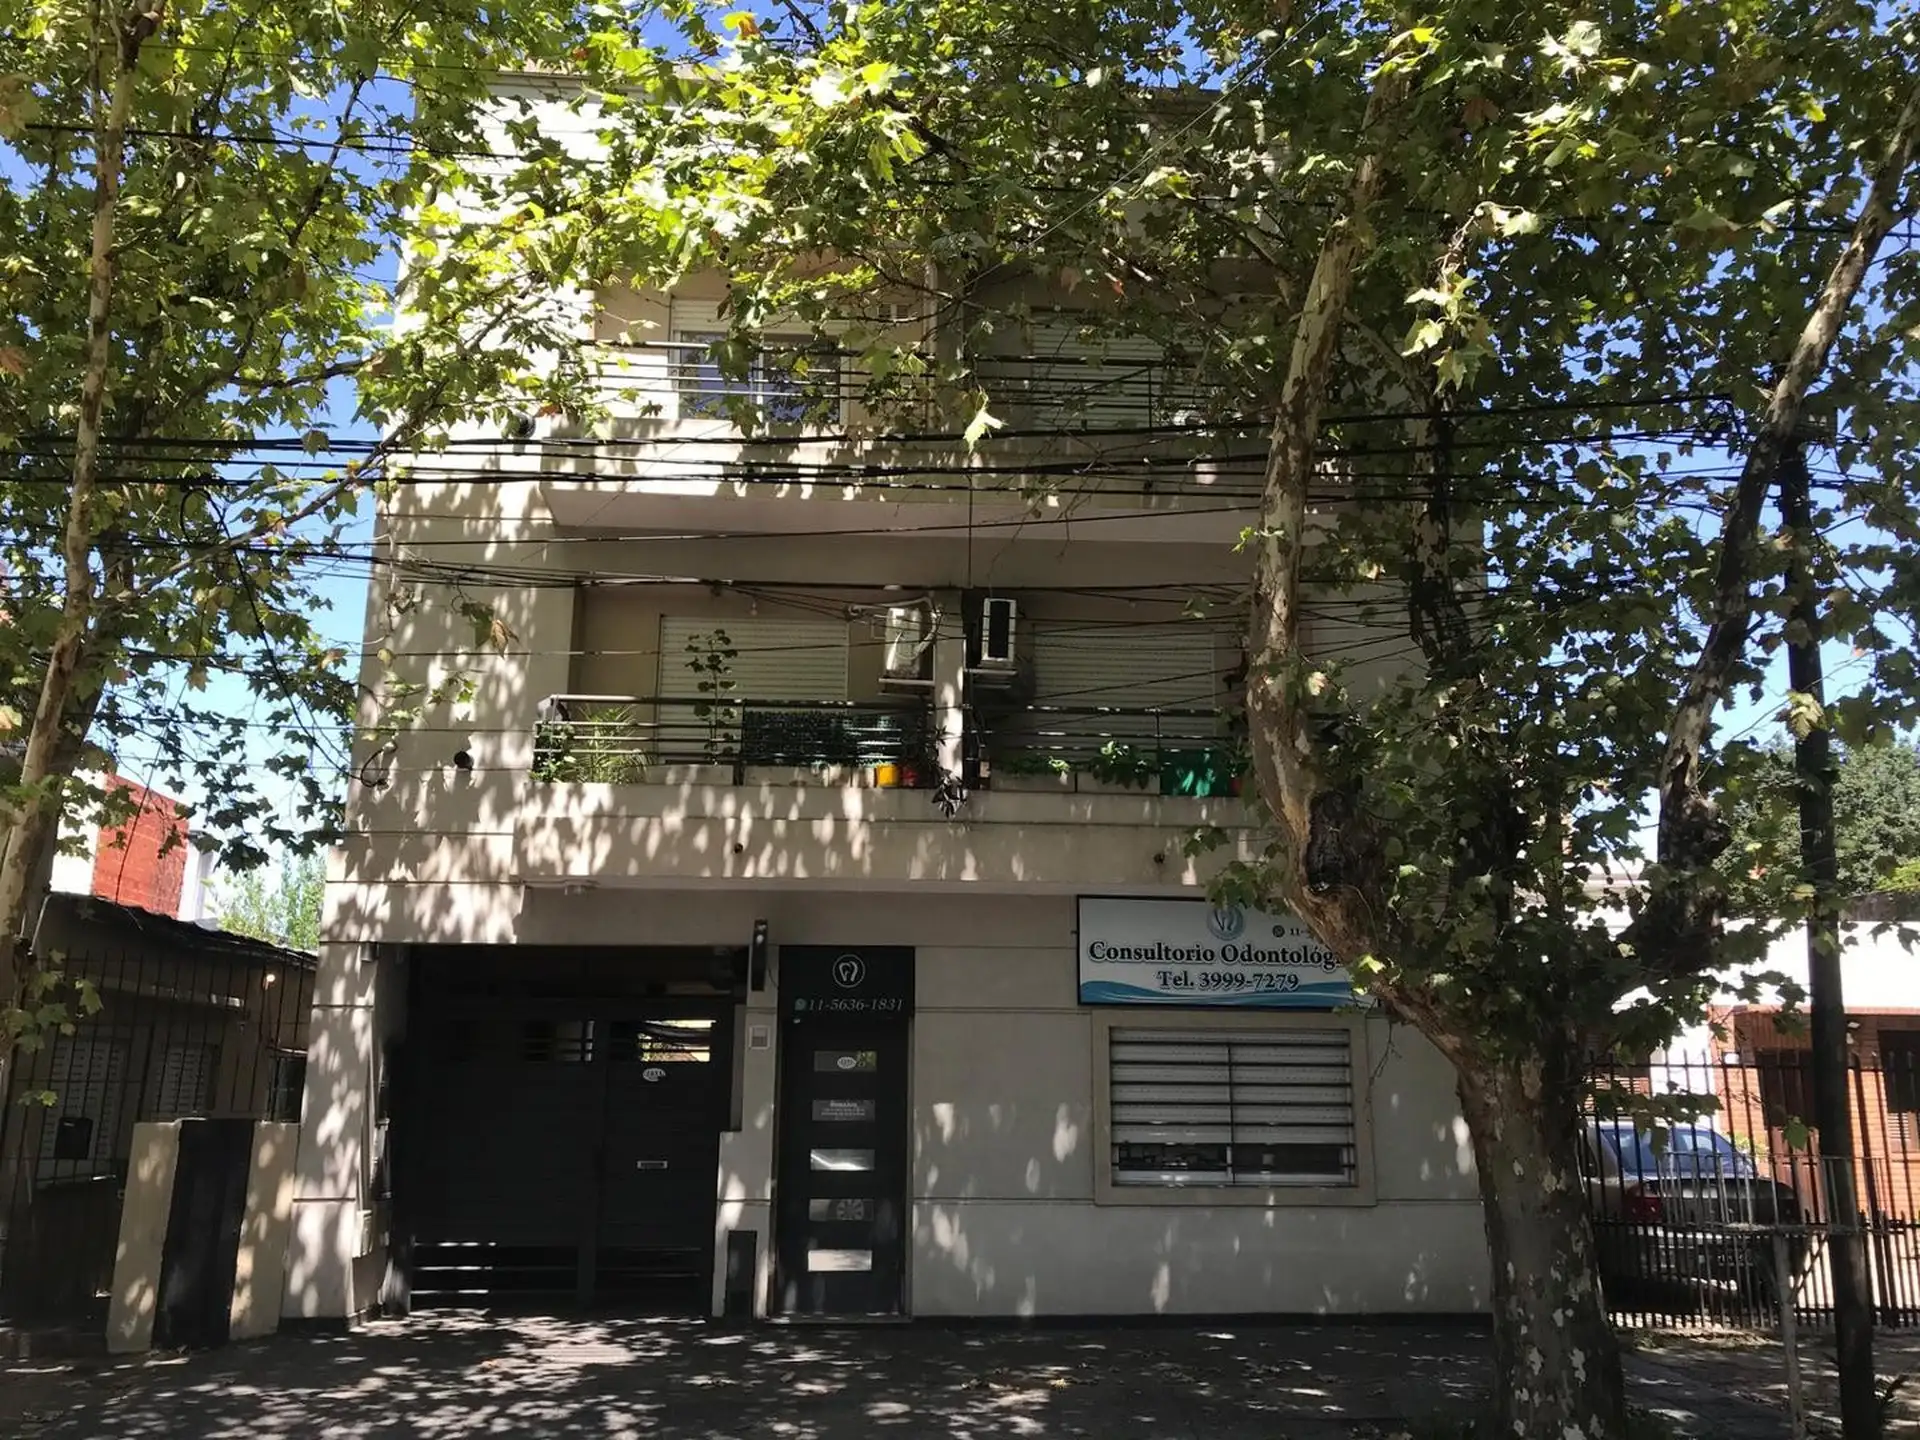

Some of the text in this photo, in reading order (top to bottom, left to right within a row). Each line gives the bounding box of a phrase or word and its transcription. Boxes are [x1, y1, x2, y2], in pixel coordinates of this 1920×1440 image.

[1089, 941, 1215, 964] Consultorio
[1158, 970, 1299, 991] Tel. 3999-7279
[808, 998, 904, 1012] 11-5636-1831
